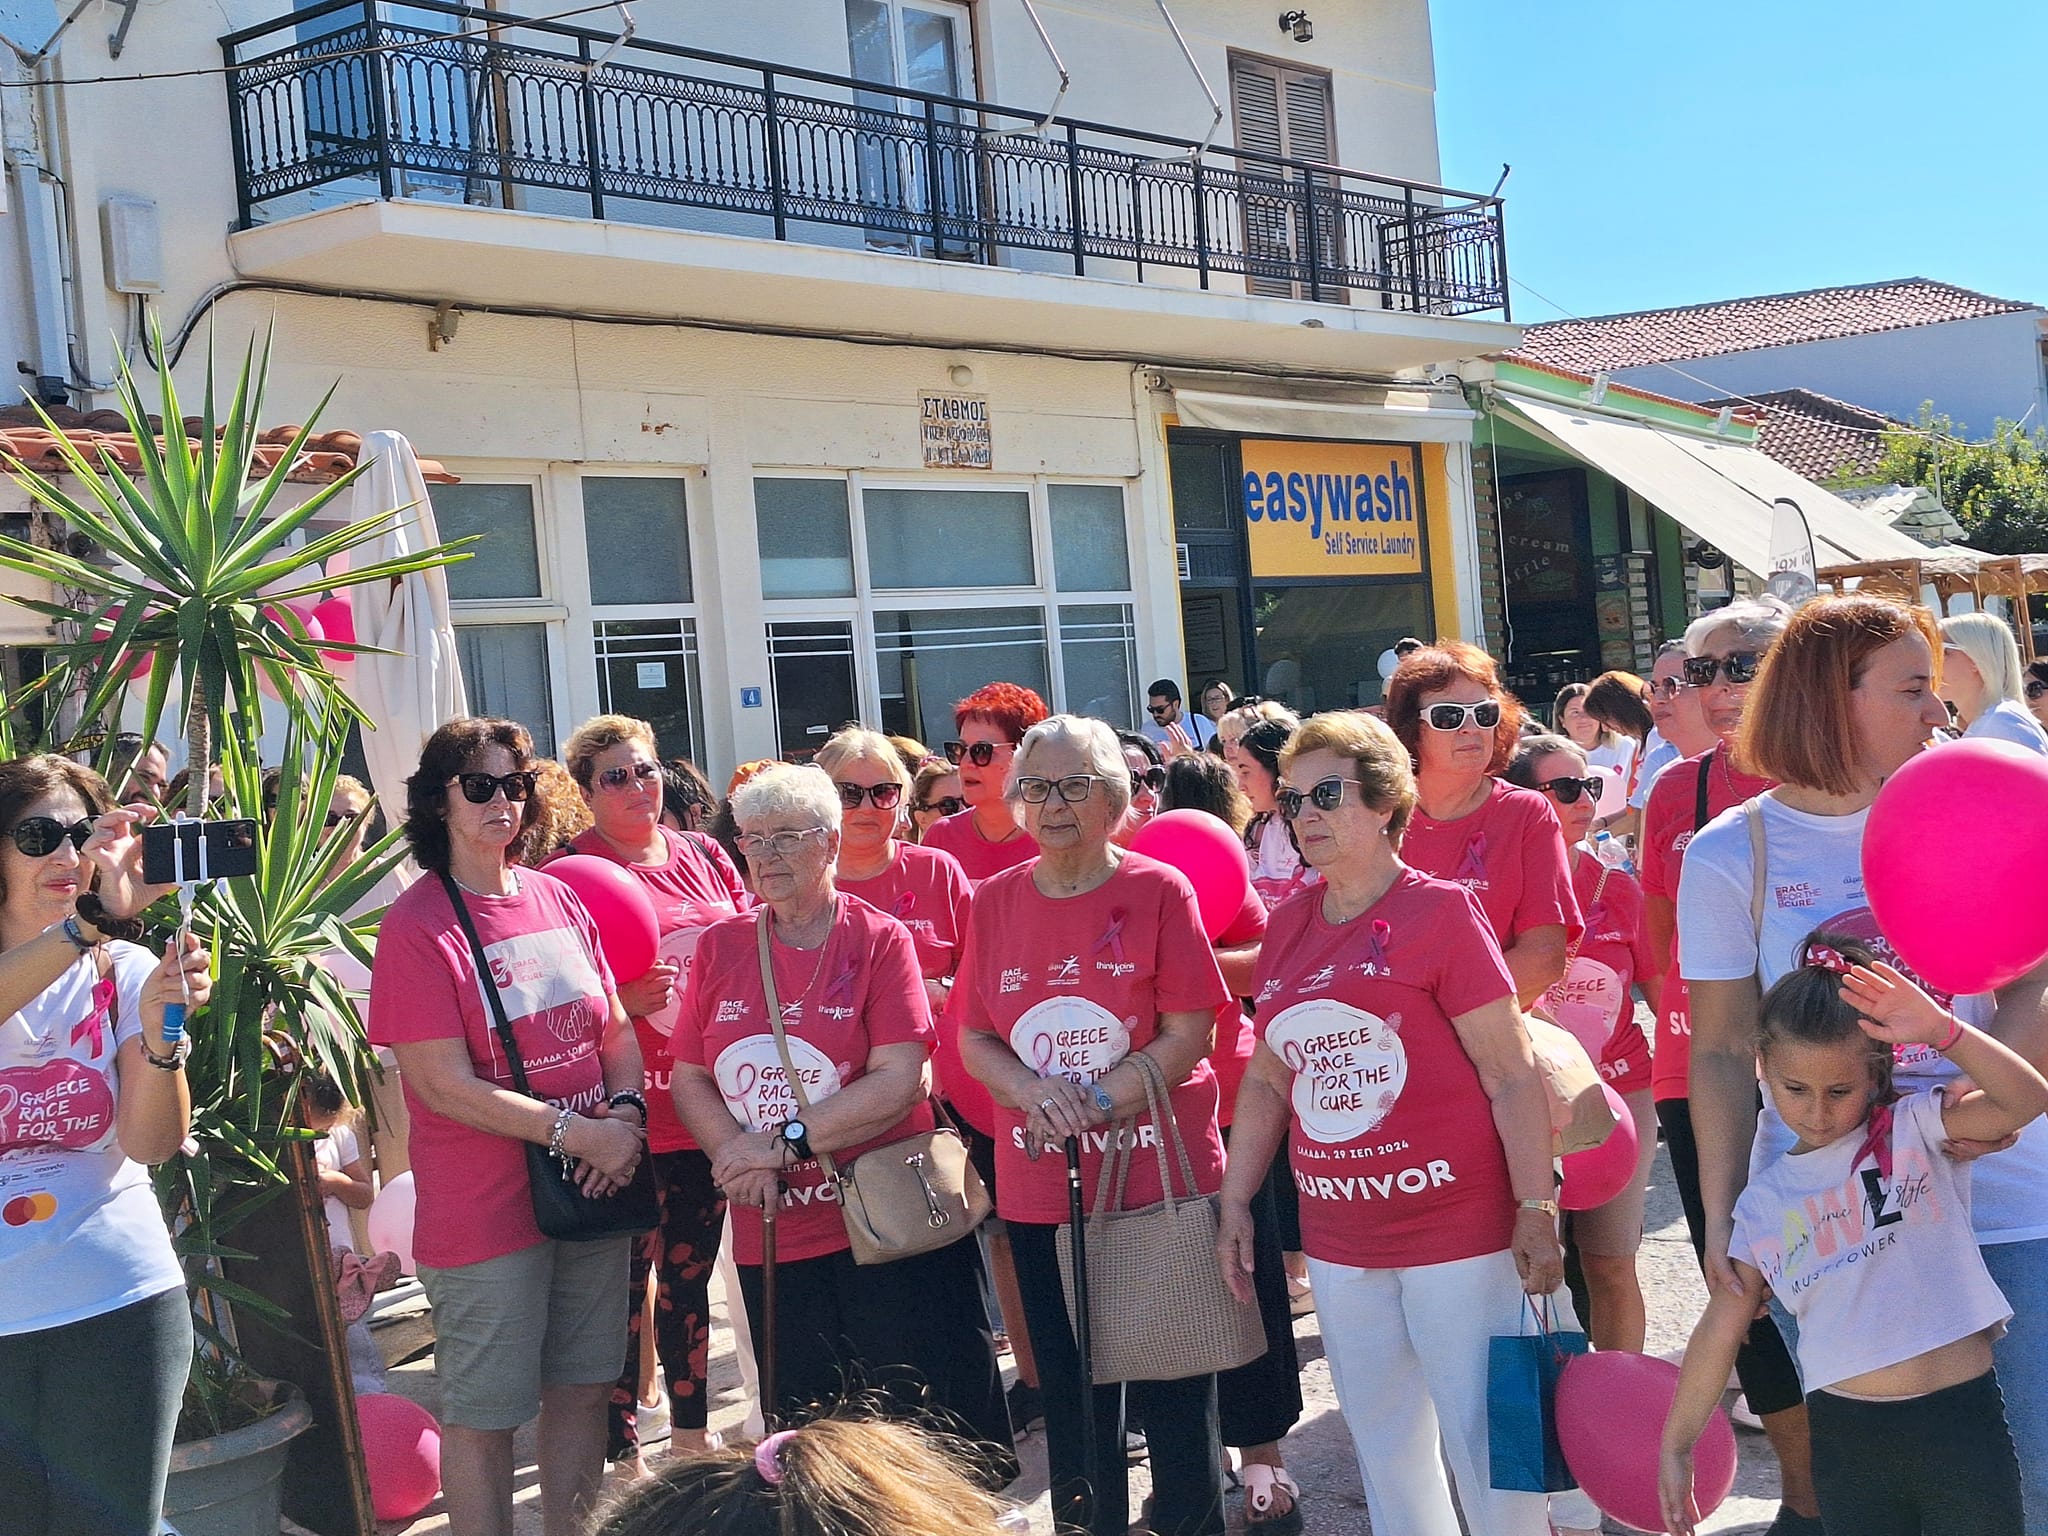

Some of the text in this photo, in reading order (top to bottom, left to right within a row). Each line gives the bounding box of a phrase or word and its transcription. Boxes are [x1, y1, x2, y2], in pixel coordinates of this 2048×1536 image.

[923, 398, 987, 421] ΣΤΑΘΜΟΣ
[1244, 460, 1412, 539] easywash
[1325, 531, 1415, 560] Self Service Laundry
[1508, 535, 1570, 553] cream
[748, 690, 756, 704] 4
[1781, 882, 1809, 893] RACE
[1783, 888, 1822, 900] FOR THE
[1057, 1027, 1109, 1048] GREECE
[1304, 1027, 1372, 1054] GREECE
[523, 1053, 562, 1069] ΕΛΛΑΔΑ
[1312, 1053, 1355, 1073] RACE
[1355, 1065, 1391, 1088] THE
[19, 1078, 92, 1107] GREECE
[1320, 1092, 1363, 1112] CURE
[18, 1100, 71, 1122] RACE
[759, 1104, 788, 1121] FOR
[16, 1114, 101, 1139] FOR THE
[1333, 1150, 1345, 1160] 29
[1350, 1147, 1373, 1160] ΣΕΠ
[1377, 1139, 1409, 1156] 2024
[1295, 1159, 1456, 1201] SURVIVOR
